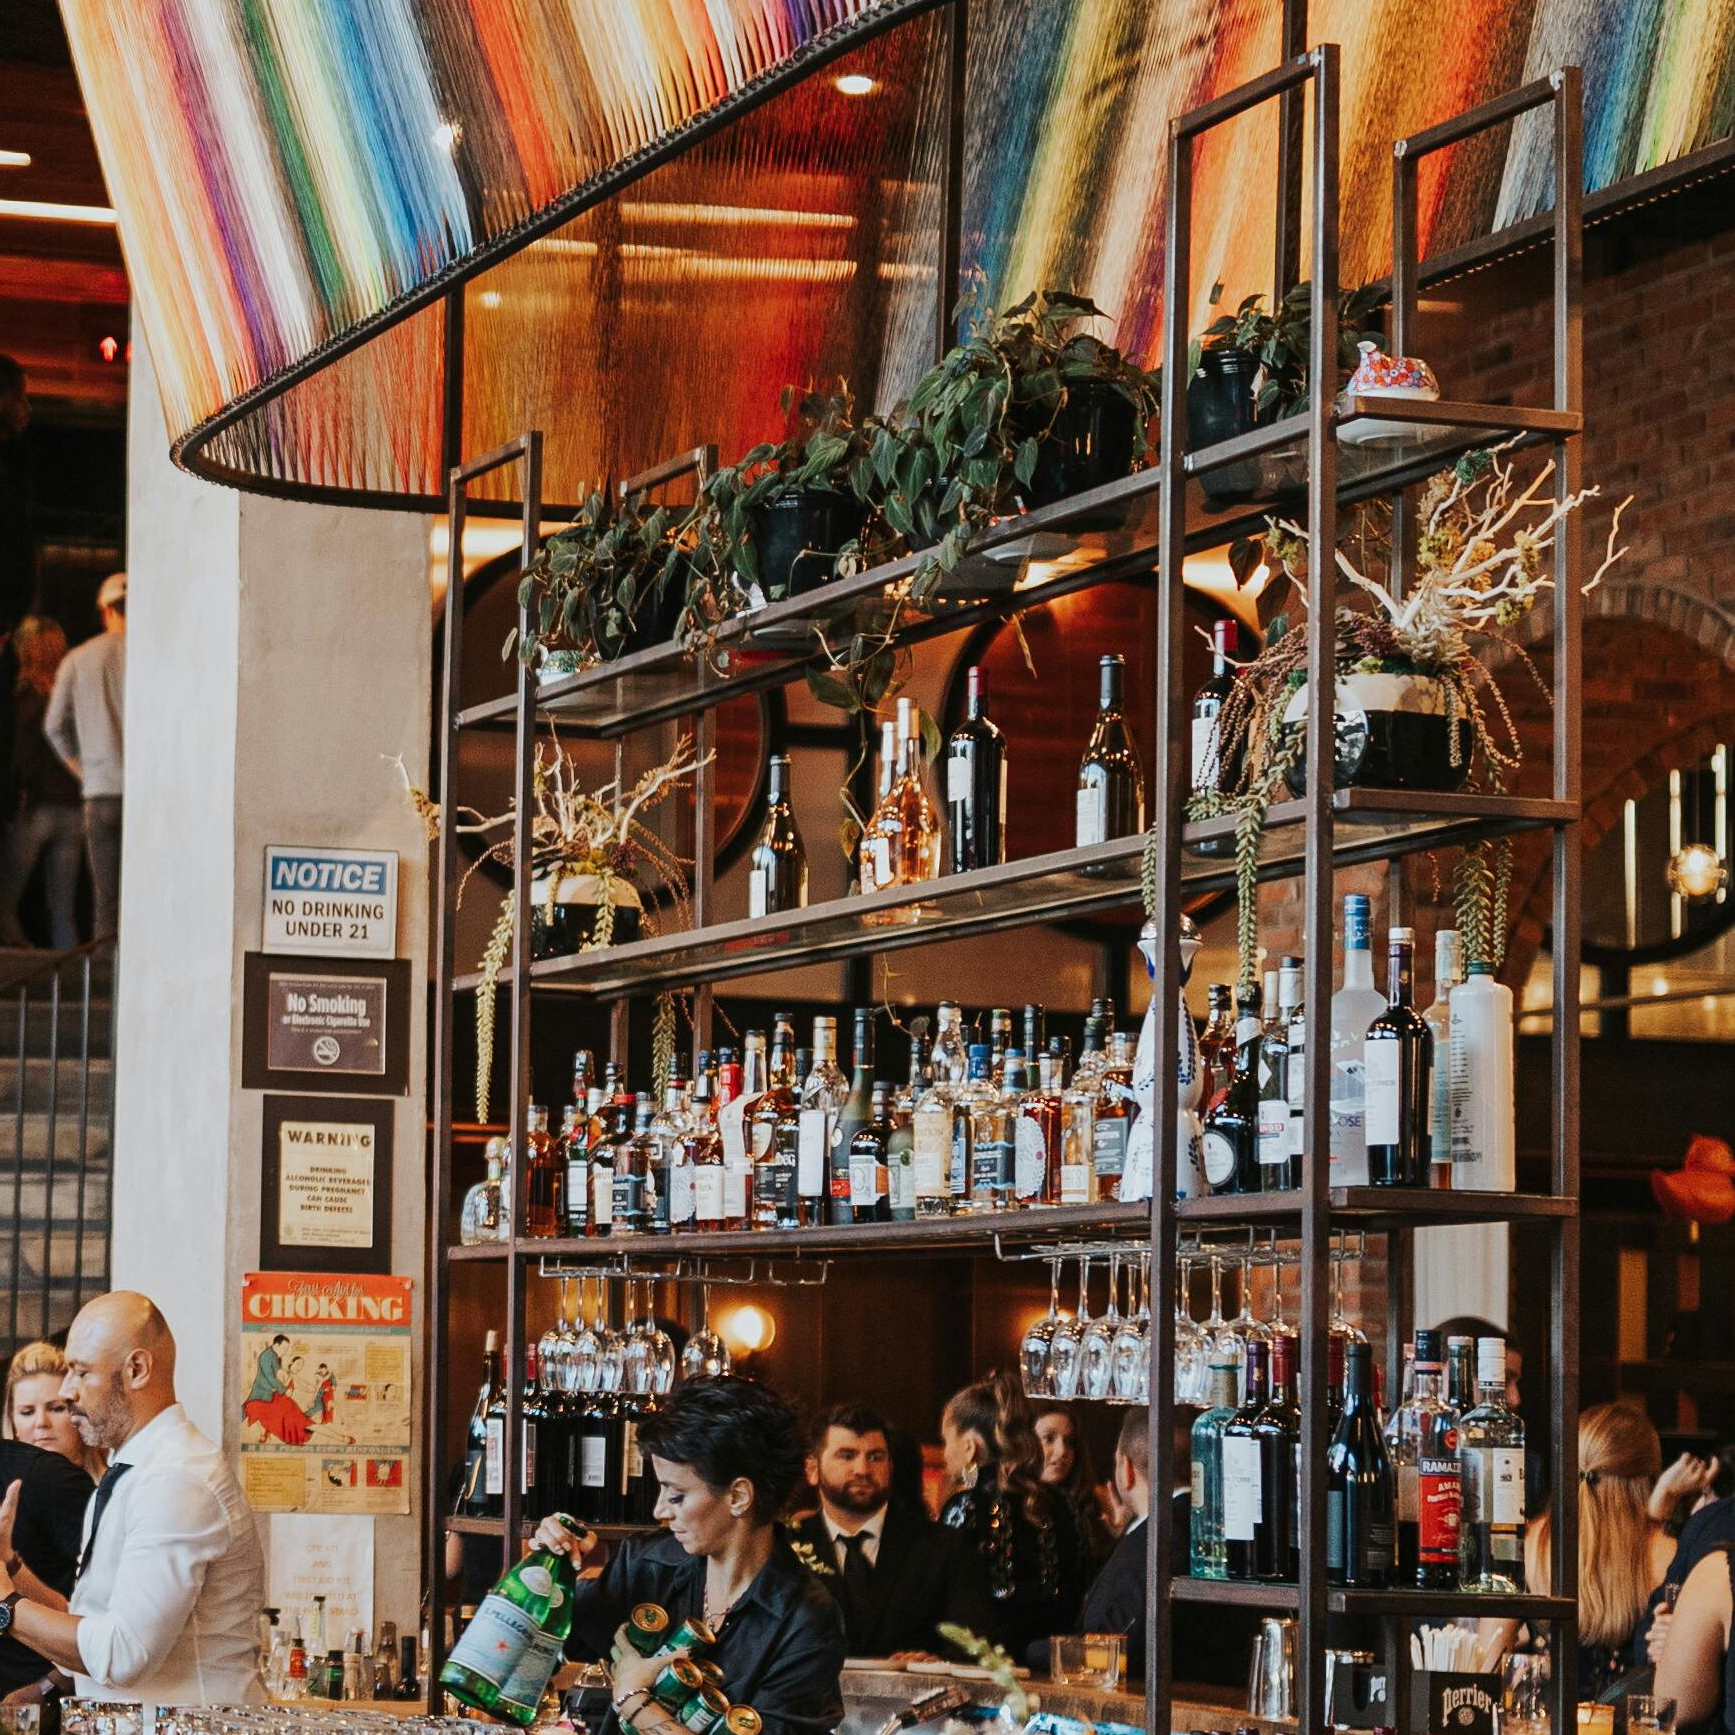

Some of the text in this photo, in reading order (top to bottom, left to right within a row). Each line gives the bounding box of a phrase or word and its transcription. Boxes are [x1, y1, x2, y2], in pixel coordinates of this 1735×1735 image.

[275, 861, 382, 891] NOTICE
[272, 900, 384, 919] NO DRINKING
[285, 921, 369, 940] UNDER 21
[287, 993, 367, 1016] No Smoking
[292, 1014, 325, 1025] Electronic
[326, 1016, 357, 1027] Cigarette
[288, 1130, 372, 1147] WARNING
[310, 1166, 346, 1174] DRINKING
[286, 1174, 370, 1185] ALCOHOLIC BEVERAGES
[289, 1184, 365, 1195] DURING PREGNANCY
[324, 1205, 353, 1213] DEFECTS
[248, 1293, 403, 1321] CHOKING
